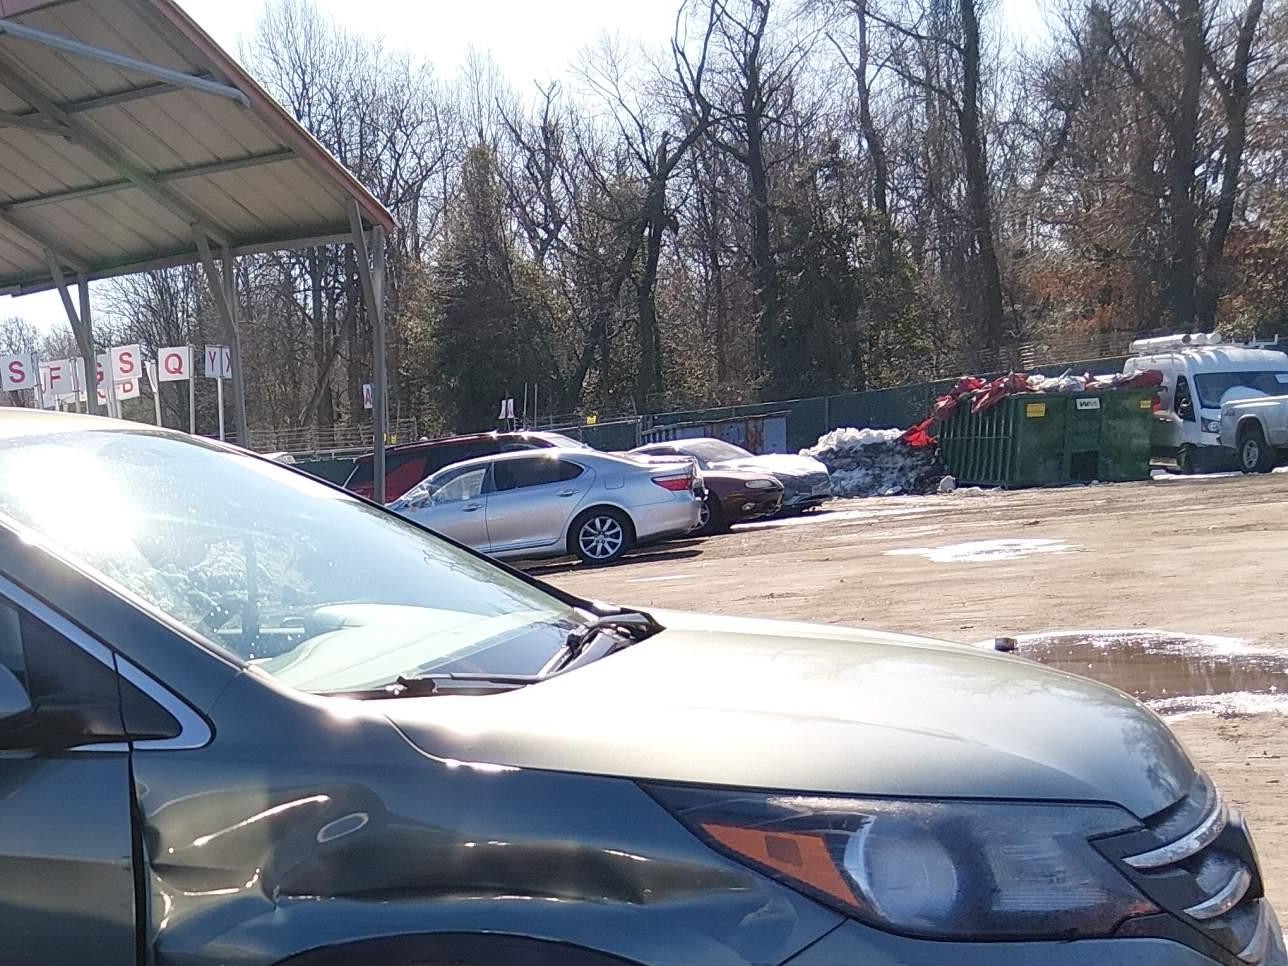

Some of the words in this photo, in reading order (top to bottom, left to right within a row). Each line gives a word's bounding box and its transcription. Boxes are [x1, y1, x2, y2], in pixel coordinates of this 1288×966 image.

[8, 360, 26, 384] S
[119, 351, 135, 374] S
[164, 353, 184, 375] Q
[208, 351, 217, 373] Y
[49, 366, 62, 389] F
